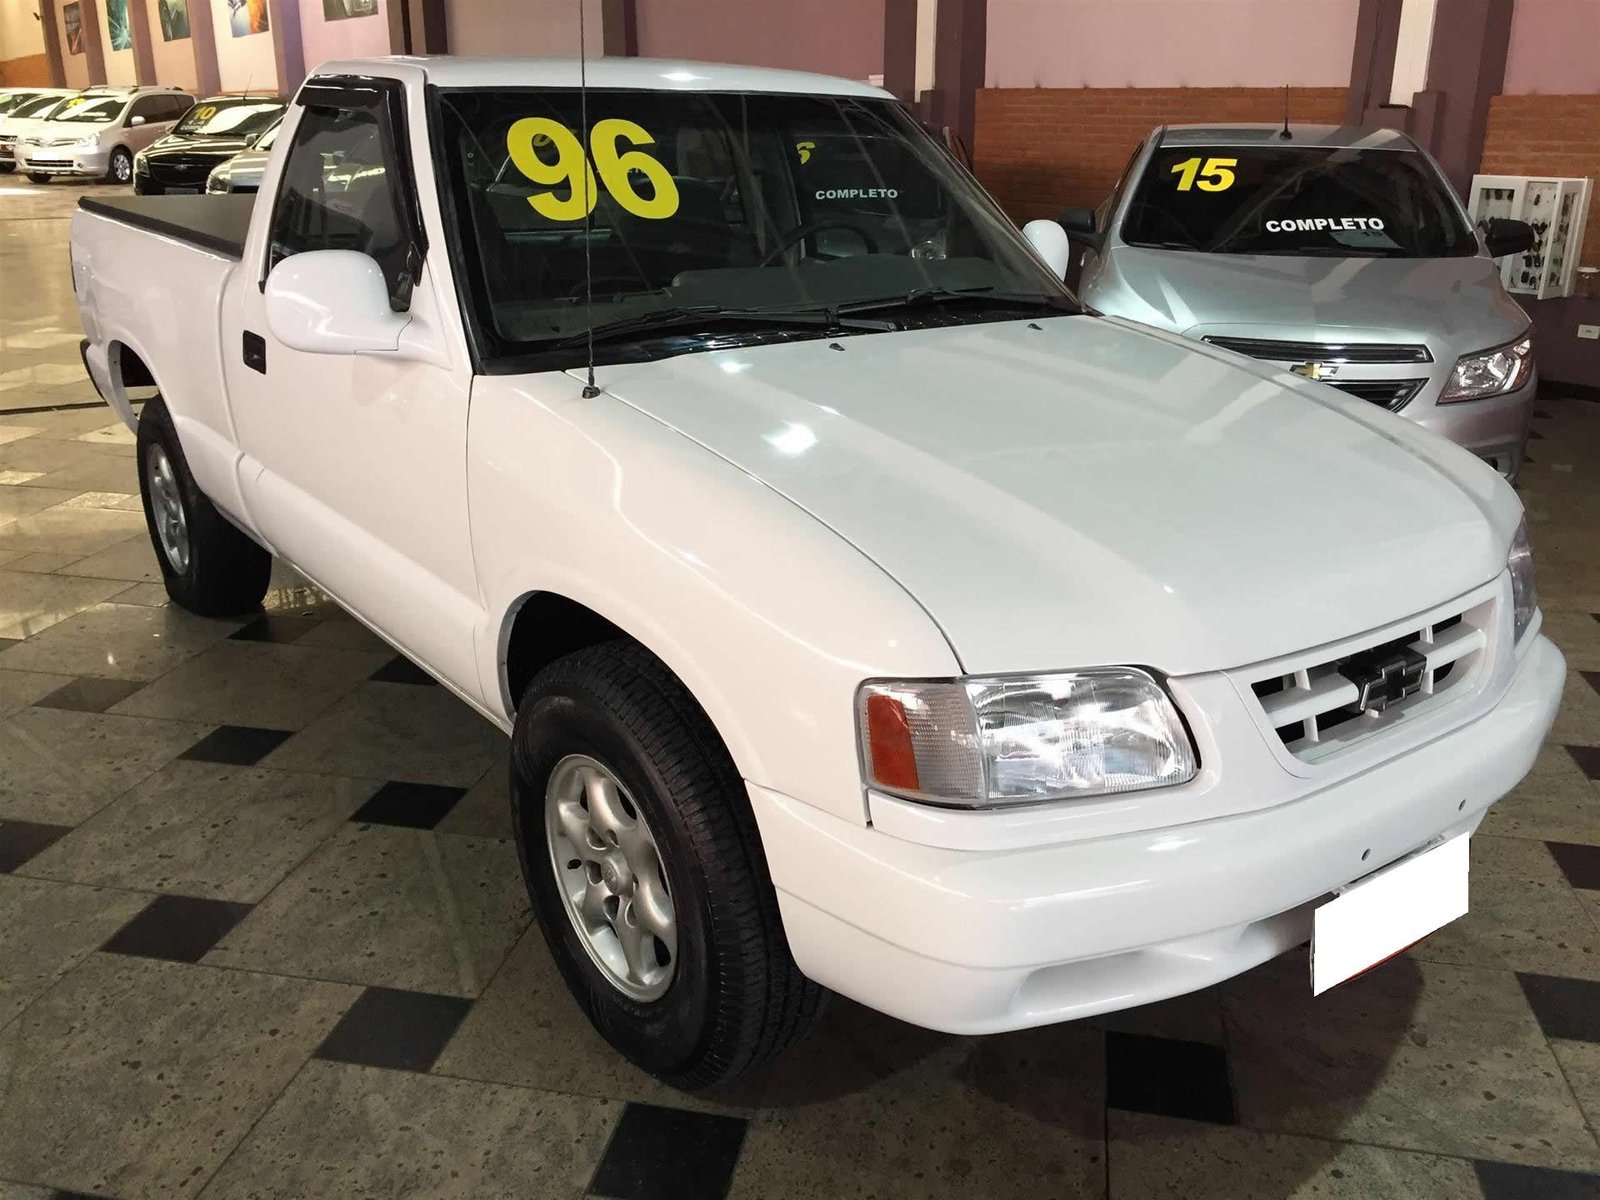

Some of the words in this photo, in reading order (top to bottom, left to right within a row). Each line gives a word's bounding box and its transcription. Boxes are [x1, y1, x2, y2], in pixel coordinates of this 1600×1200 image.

[194, 106, 217, 122] 10
[507, 117, 680, 221] 96
[1171, 158, 1238, 192] 15
[815, 188, 898, 200] COMPLETO
[1265, 217, 1385, 233] COMPLETO
